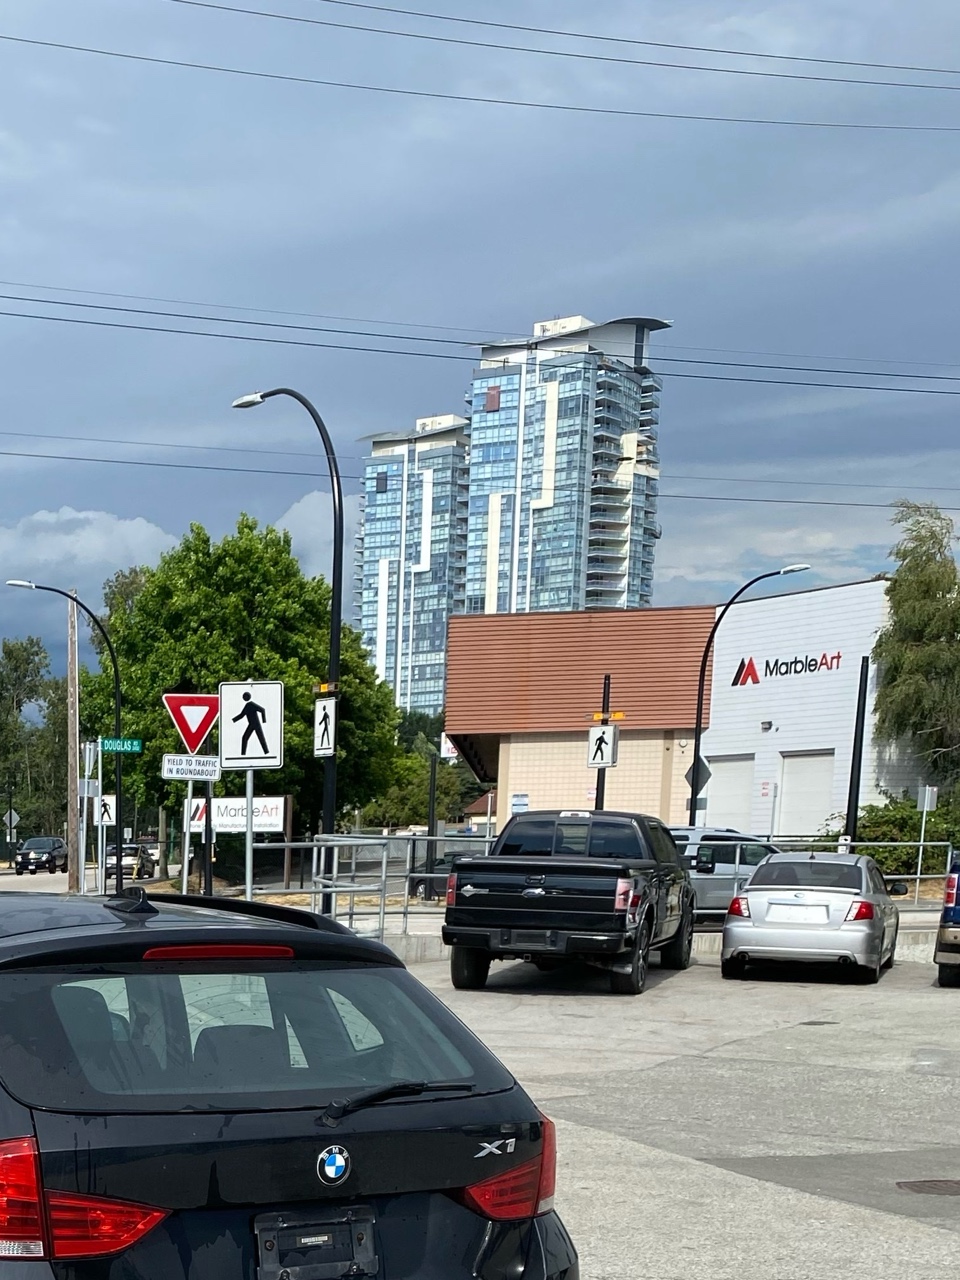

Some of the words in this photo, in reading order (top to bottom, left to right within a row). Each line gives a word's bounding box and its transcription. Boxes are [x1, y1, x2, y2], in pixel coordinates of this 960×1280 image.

[764, 652, 842, 677] MarbleArt
[104, 740, 131, 751] DOUGLAS
[167, 758, 183, 766] YIELD
[185, 758, 193, 767] TO
[195, 759, 217, 768] TRAFFIC
[176, 768, 217, 777] ROUNDABOUT
[216, 804, 279, 818] MarbeArt
[321, 1147, 349, 1160] BMW
[473, 1138, 516, 1158] X1
